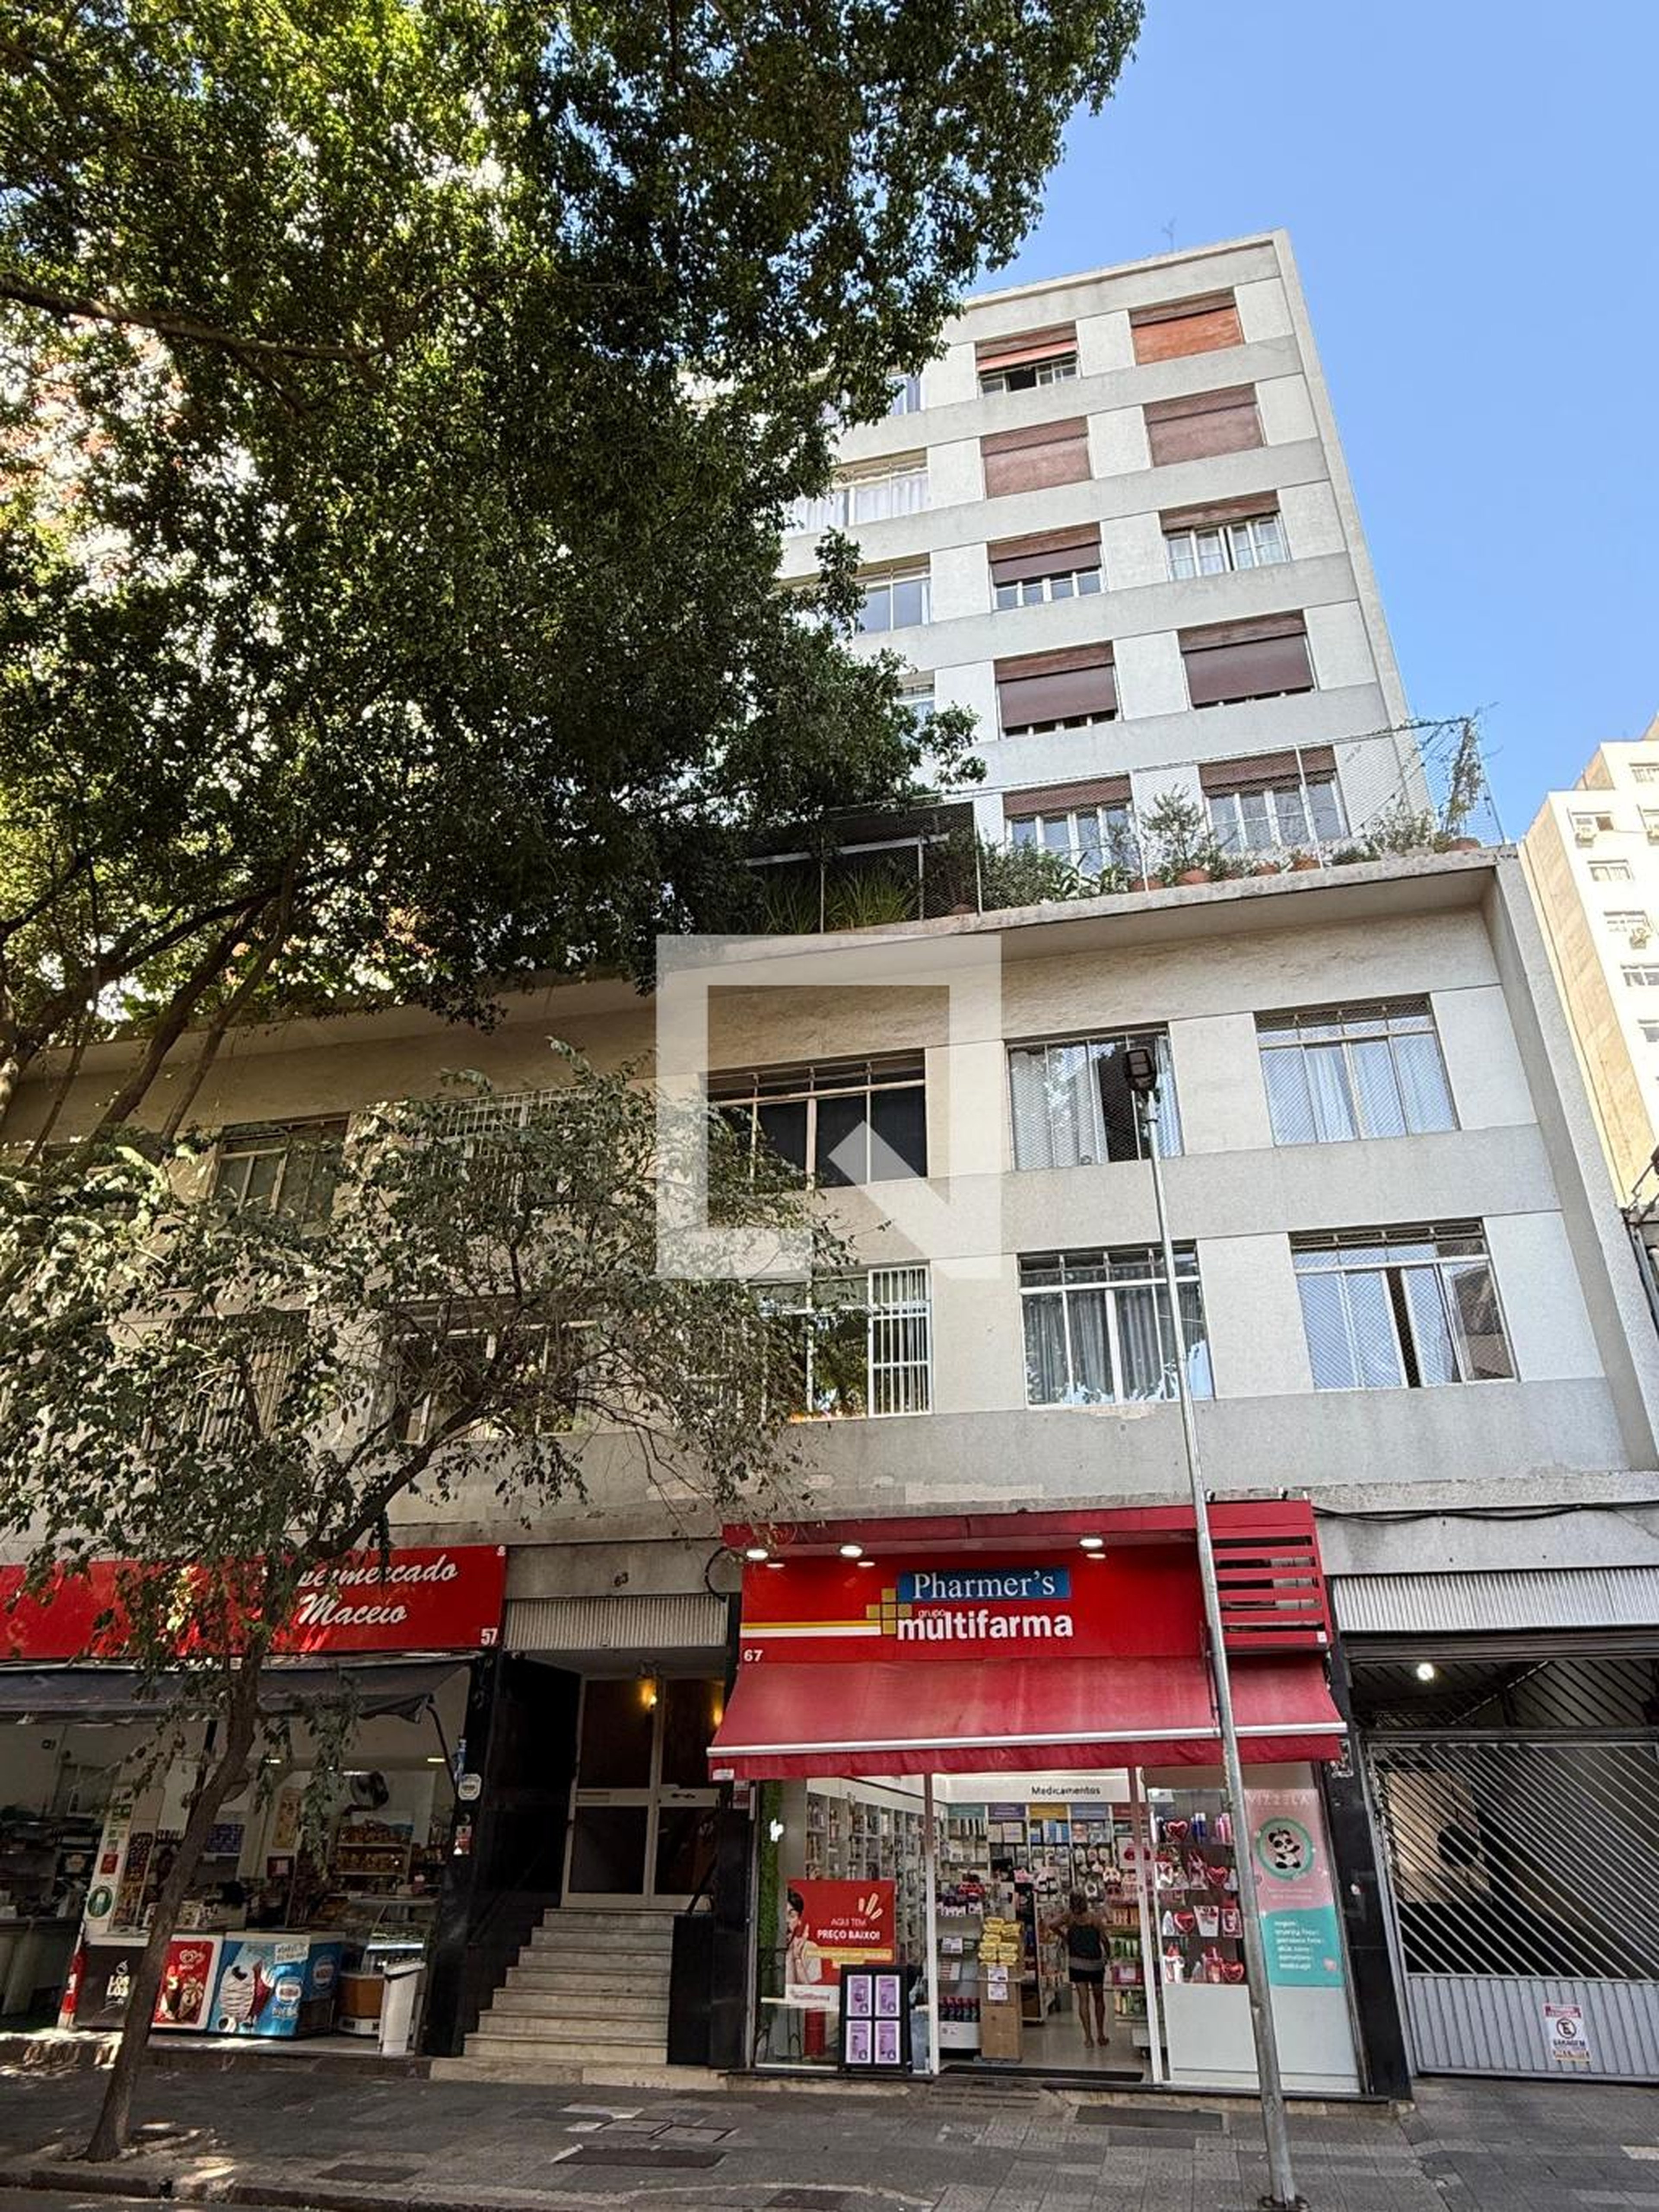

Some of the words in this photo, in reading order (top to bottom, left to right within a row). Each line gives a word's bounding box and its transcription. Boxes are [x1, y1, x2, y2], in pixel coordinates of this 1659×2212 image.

[913, 1570, 1055, 1599] Pharmer's
[918, 1609, 945, 1619] grupo
[897, 1609, 1073, 1640] multifarma
[480, 1627, 498, 1645] 57
[744, 1649, 763, 1662] 67
[1031, 1786, 1101, 1795] Medicamentos
[831, 1918, 849, 1926] AQUI
[851, 1918, 866, 1926] TEM
[817, 1929, 846, 1940] PREÇO
[848, 1929, 880, 1940] BAIXO!
